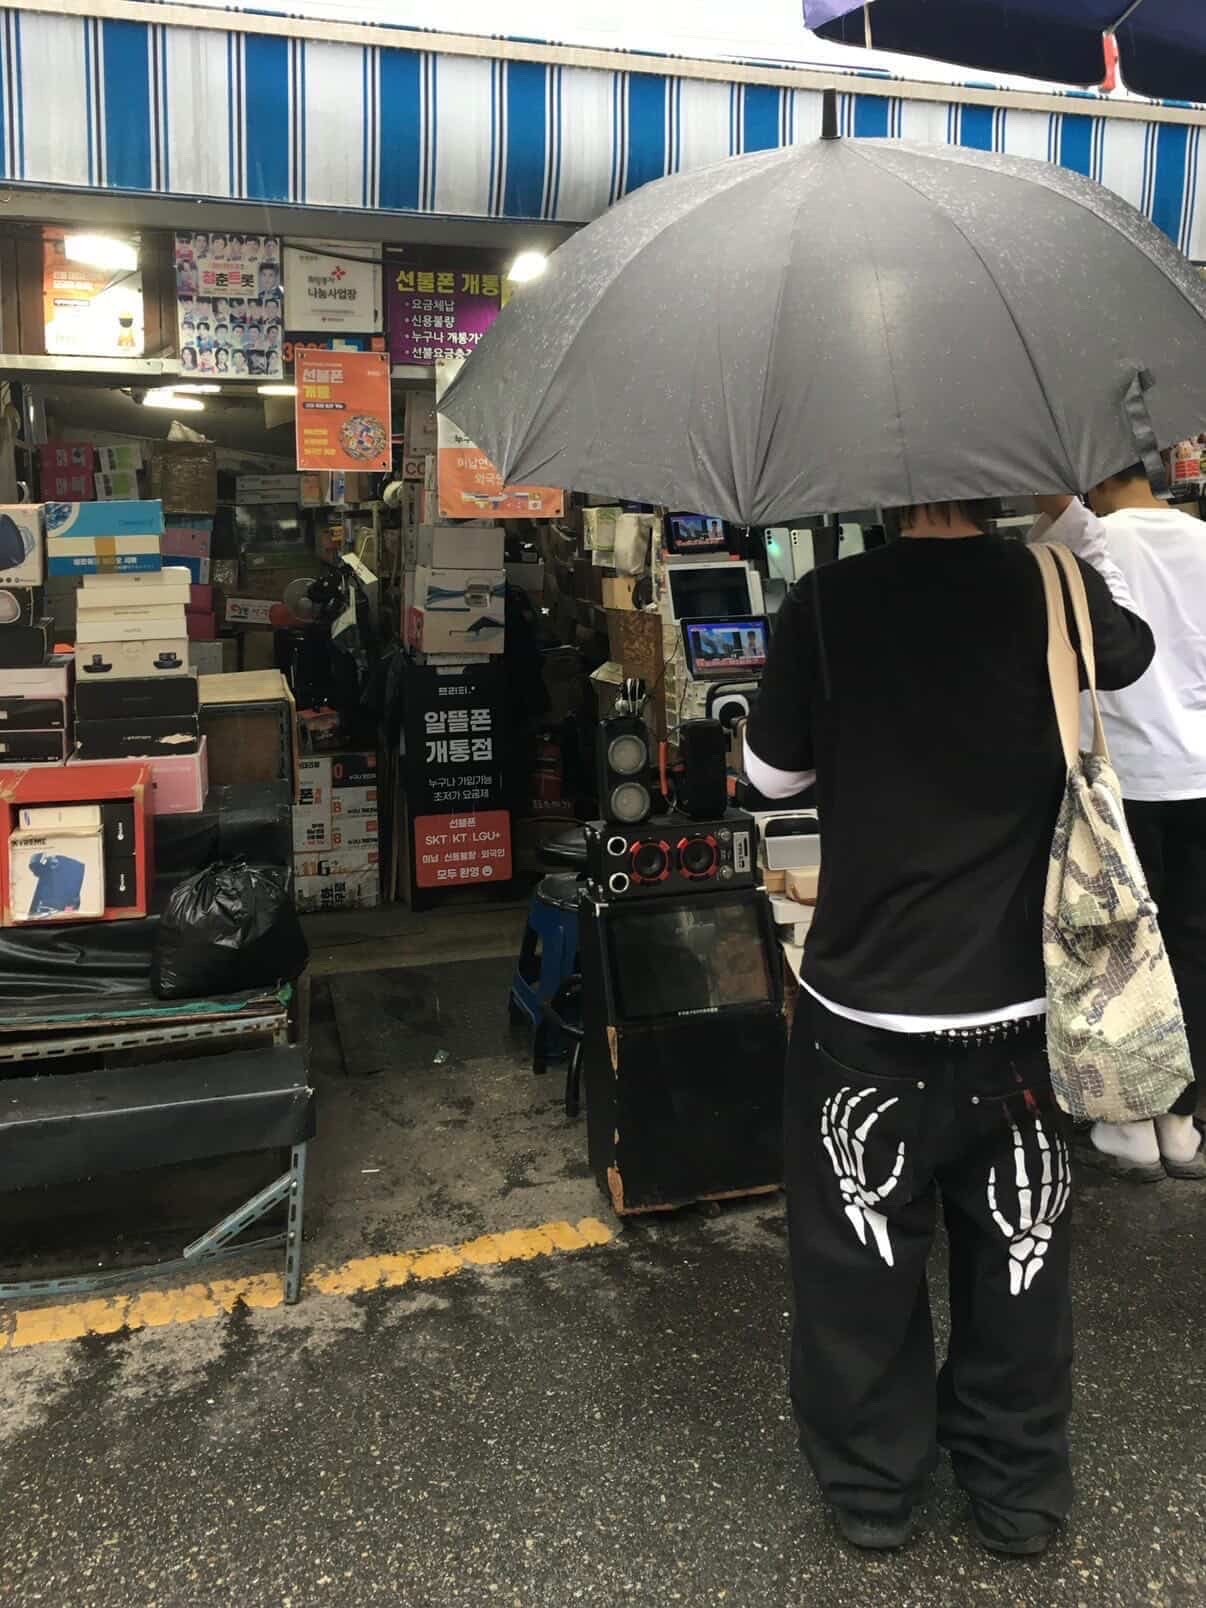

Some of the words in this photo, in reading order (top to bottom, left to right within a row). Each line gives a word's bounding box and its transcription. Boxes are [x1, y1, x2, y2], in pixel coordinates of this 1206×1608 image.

[396, 270, 455, 294] 선불폰
[308, 287, 357, 300] 나눔사업장
[412, 299, 455, 312] 요금체납
[412, 315, 455, 328] 신용불량
[412, 331, 444, 343] 누구나
[424, 708, 491, 734] 알뜰폰
[425, 738, 492, 763] 개통점
[428, 777, 456, 788] 누구나
[457, 775, 493, 786] 가입가능
[462, 788, 489, 799] 요금제
[449, 817, 477, 829] 선불폰
[425, 834, 448, 846] SKT
[452, 833, 468, 843] KT
[472, 831, 500, 842] LGU+
[437, 868, 457, 880] 모두
[459, 866, 480, 878] 환영
